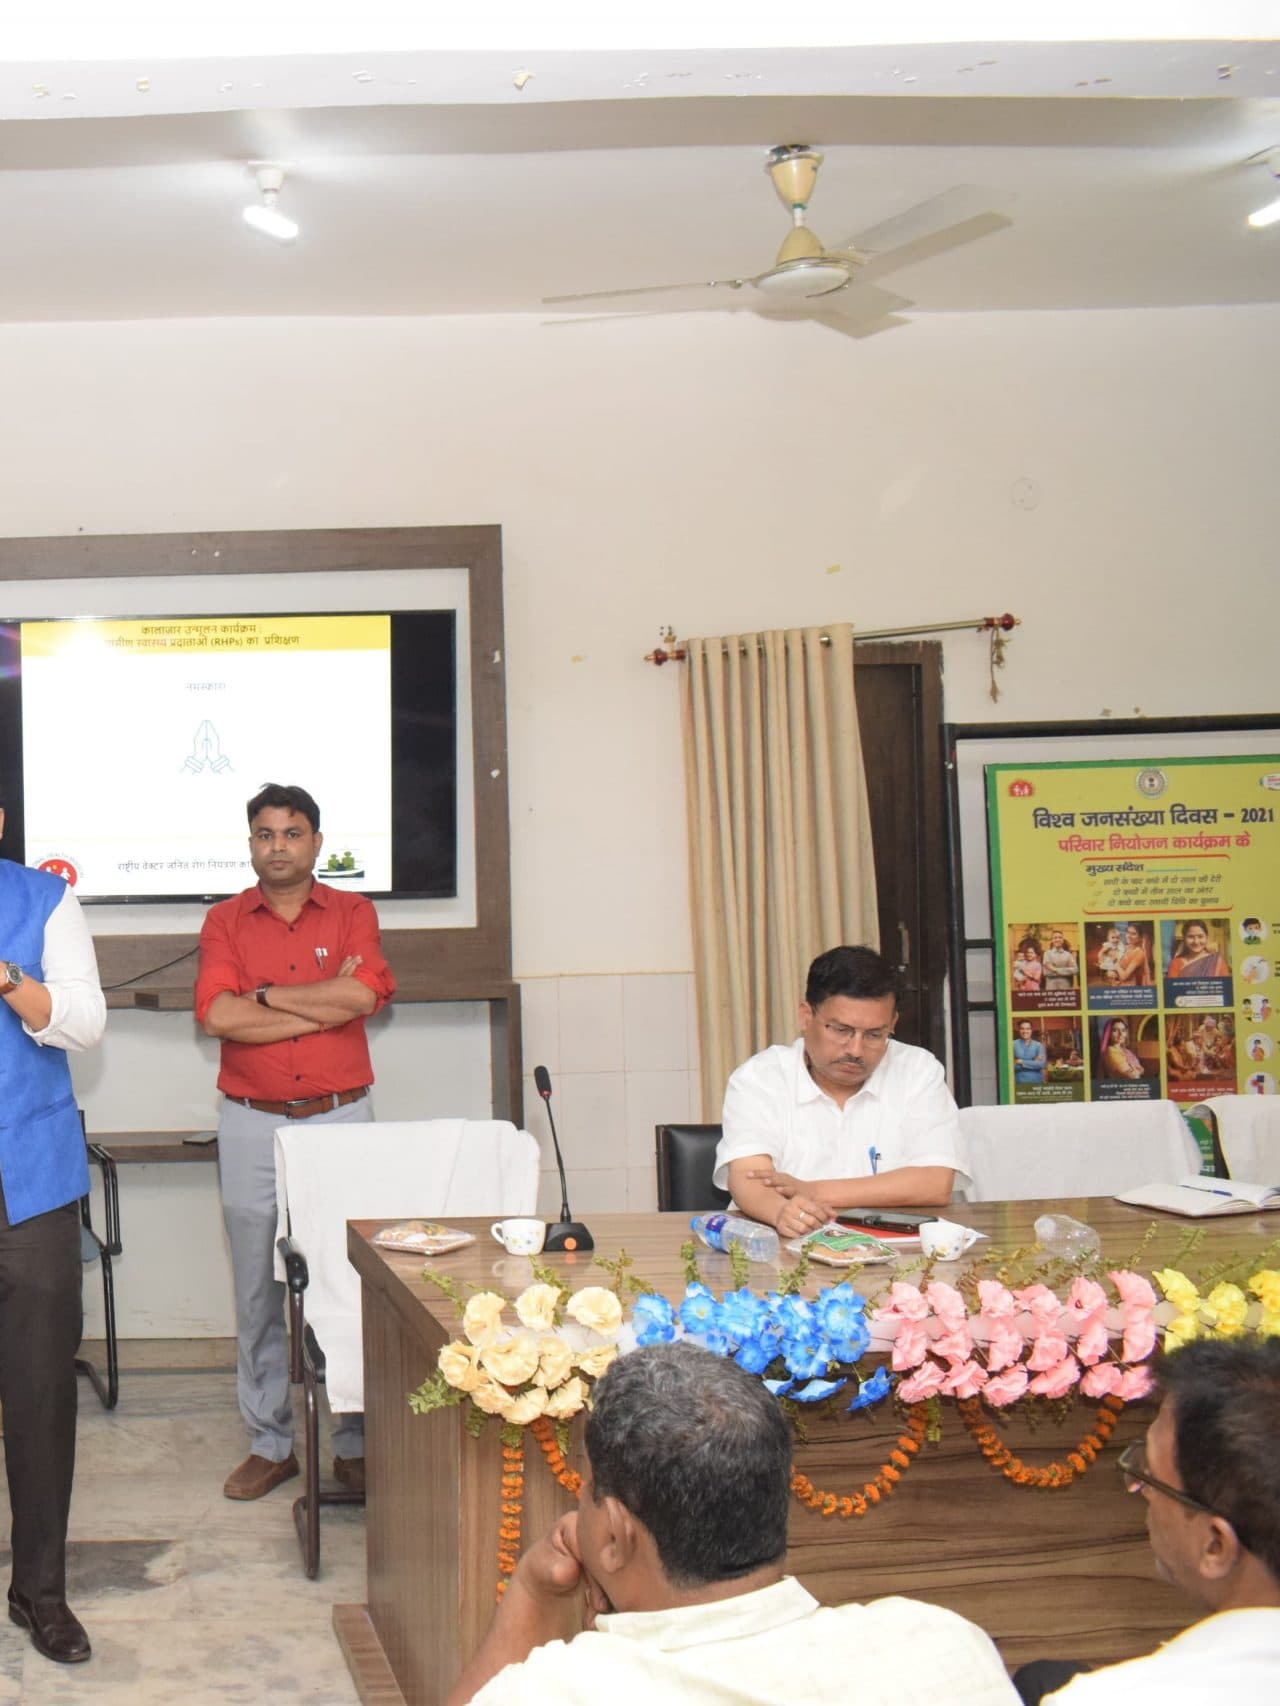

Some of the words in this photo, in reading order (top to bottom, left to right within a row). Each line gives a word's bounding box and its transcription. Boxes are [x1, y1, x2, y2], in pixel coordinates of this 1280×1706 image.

[211, 637, 243, 647] (RHPs)
[246, 636, 258, 645] का
[1032, 807, 1075, 829] विश्व
[1080, 805, 1165, 827] जनसंख्या
[1170, 803, 1218, 825] दिवस
[1241, 808, 1274, 823] 2021
[1058, 834, 1104, 852] परिवार
[1109, 833, 1168, 851] नियोजन
[1173, 831, 1230, 850] कार्यक्रम
[1235, 831, 1250, 848] के
